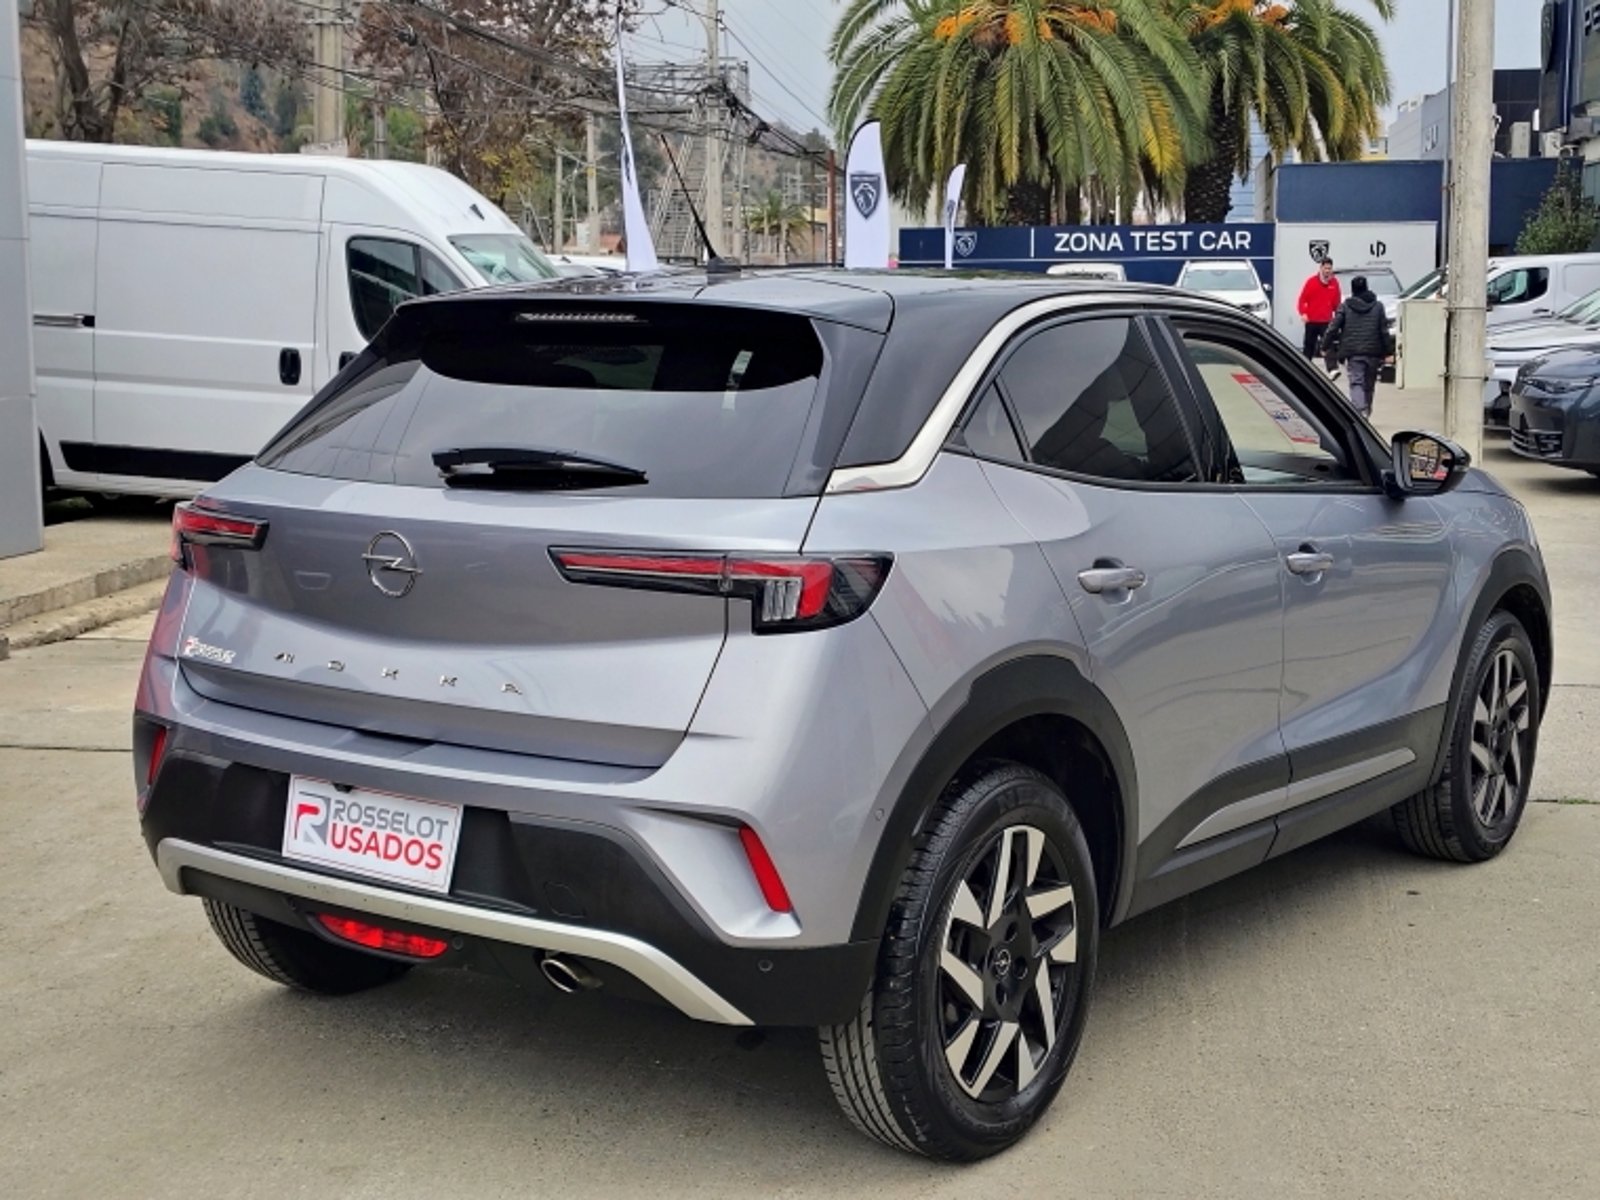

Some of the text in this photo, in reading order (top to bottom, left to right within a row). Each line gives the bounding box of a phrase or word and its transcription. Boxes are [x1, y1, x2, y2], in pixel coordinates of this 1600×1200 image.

[1054, 231, 1251, 252] ZONA TEST CAR
[332, 799, 449, 841] ROSSELOT
[331, 823, 443, 870] USADOS
